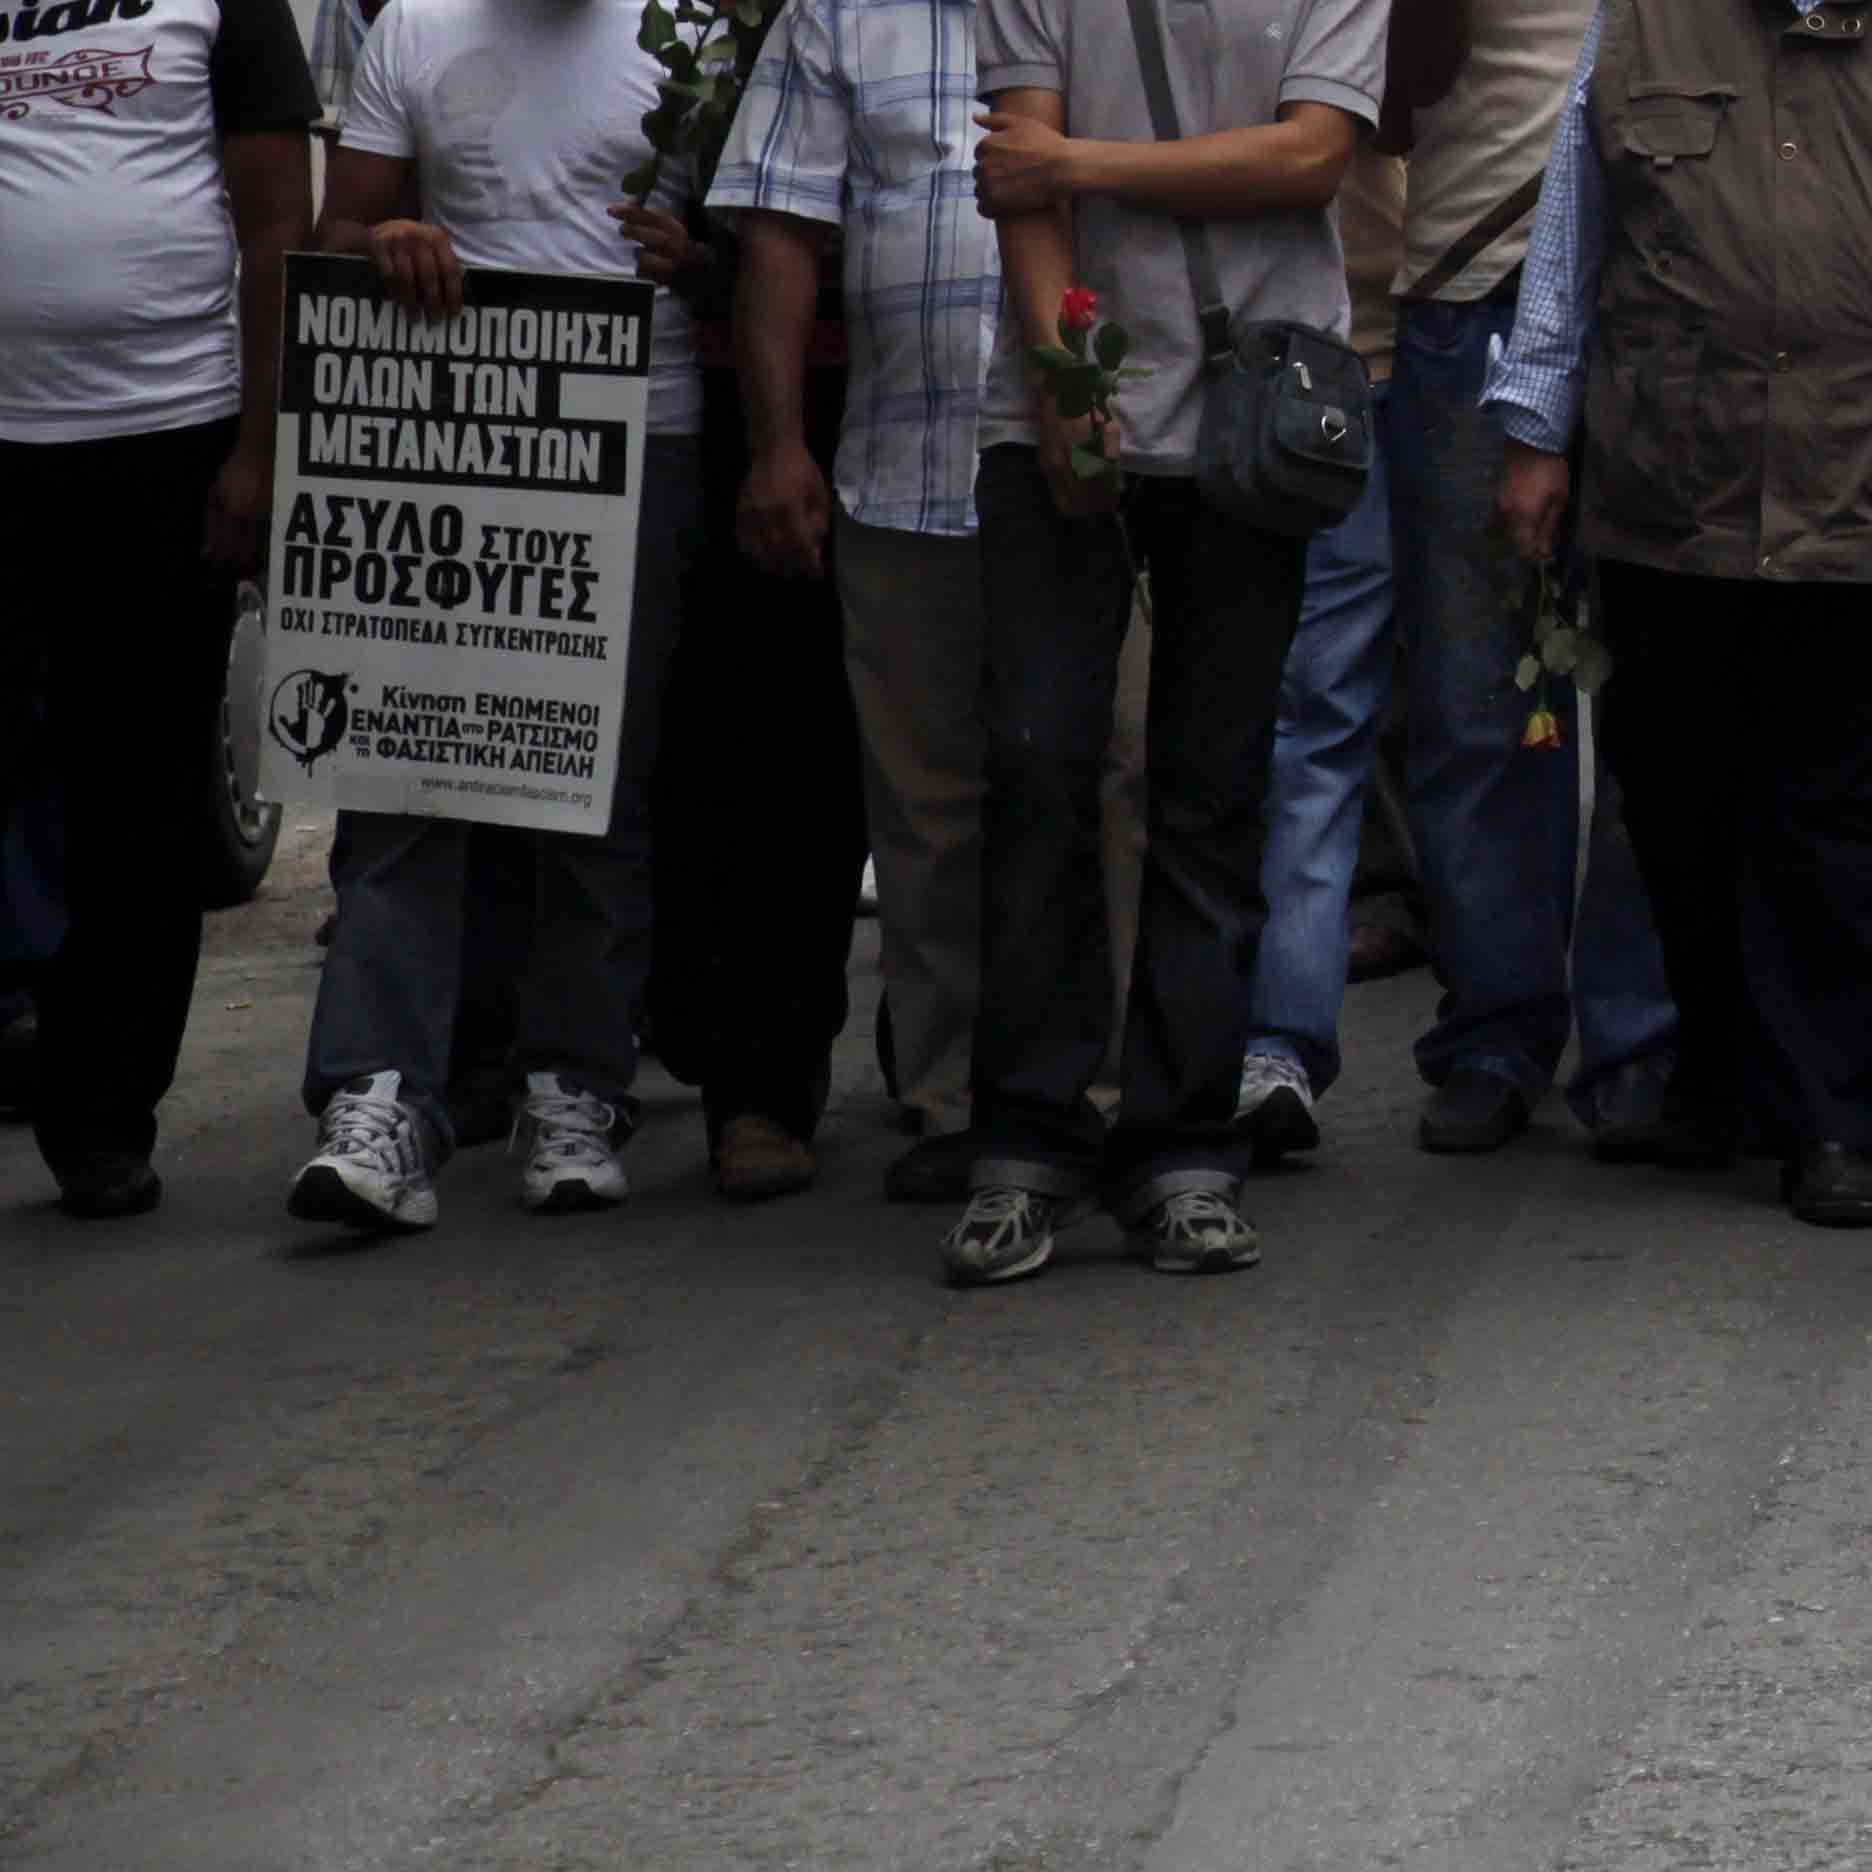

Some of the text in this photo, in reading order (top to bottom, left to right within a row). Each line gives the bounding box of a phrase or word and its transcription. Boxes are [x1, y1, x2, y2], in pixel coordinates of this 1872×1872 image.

[313, 353, 538, 417] ΟΛΩΝ ΤΩΝ
[309, 412, 601, 483] ΜΕΤΑΝΑΣΤΩΝ
[285, 492, 594, 569] ΑΣΥΛΟ ΣΤΟΥΣ
[282, 545, 601, 623] ΠΡΟΣΦΥΓΕΣ
[281, 607, 608, 660] ΟΧΙ ΣΤΡΑΤΟΠΕΔΑ ΣΥΓΚΕΝΤΡΩΣΗΣ
[351, 708, 461, 739] ΕΝΑΝΤΙΑ
[488, 717, 598, 752] ΡΑΤΣΙΣΜΟ
[382, 684, 600, 726] Κίνηση ΕΝΩΜΕΝΟΙ
[377, 737, 505, 767] ΦΑΣΙΣΤΙΚΗ
[510, 746, 594, 779] ΑΠΕΙΛΗ
